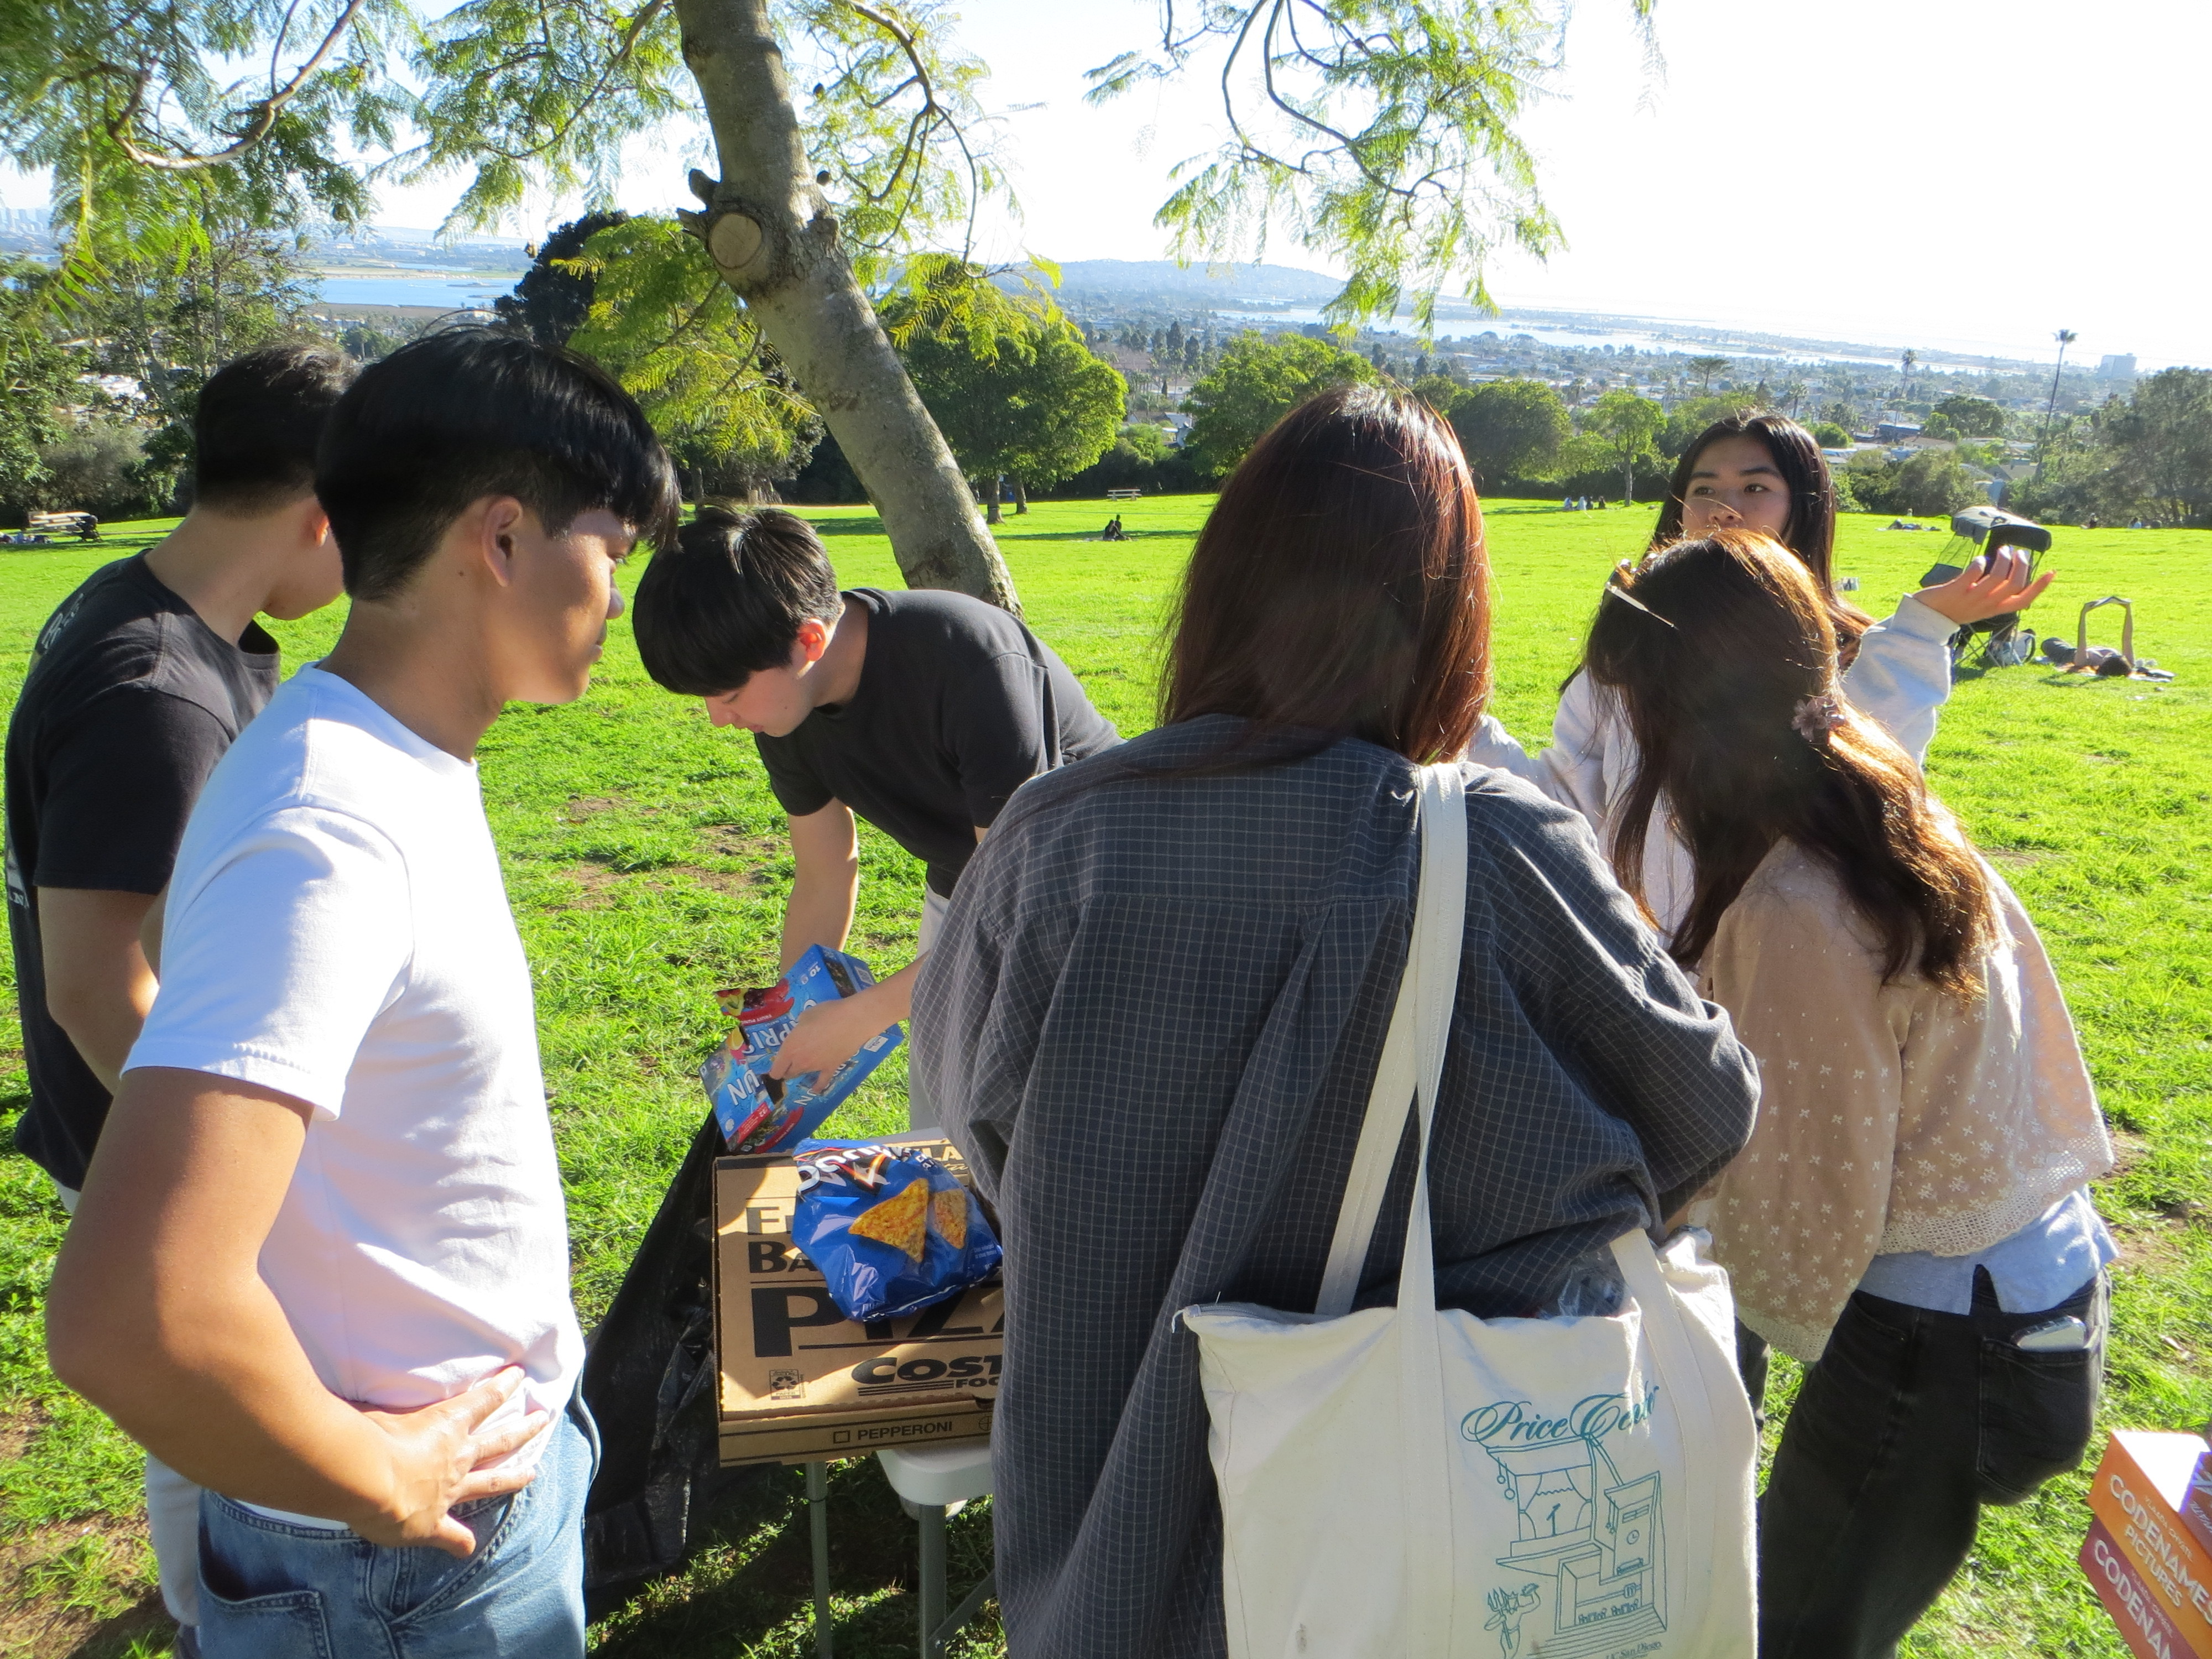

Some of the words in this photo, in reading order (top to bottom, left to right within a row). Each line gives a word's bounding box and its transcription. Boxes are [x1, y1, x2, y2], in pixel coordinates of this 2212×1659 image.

[727, 1070, 764, 1106] UN
[858, 1421, 952, 1441] PEPPERONI
[1461, 1400, 1569, 1444] Price
[2124, 1524, 2183, 1607] PICTURES
